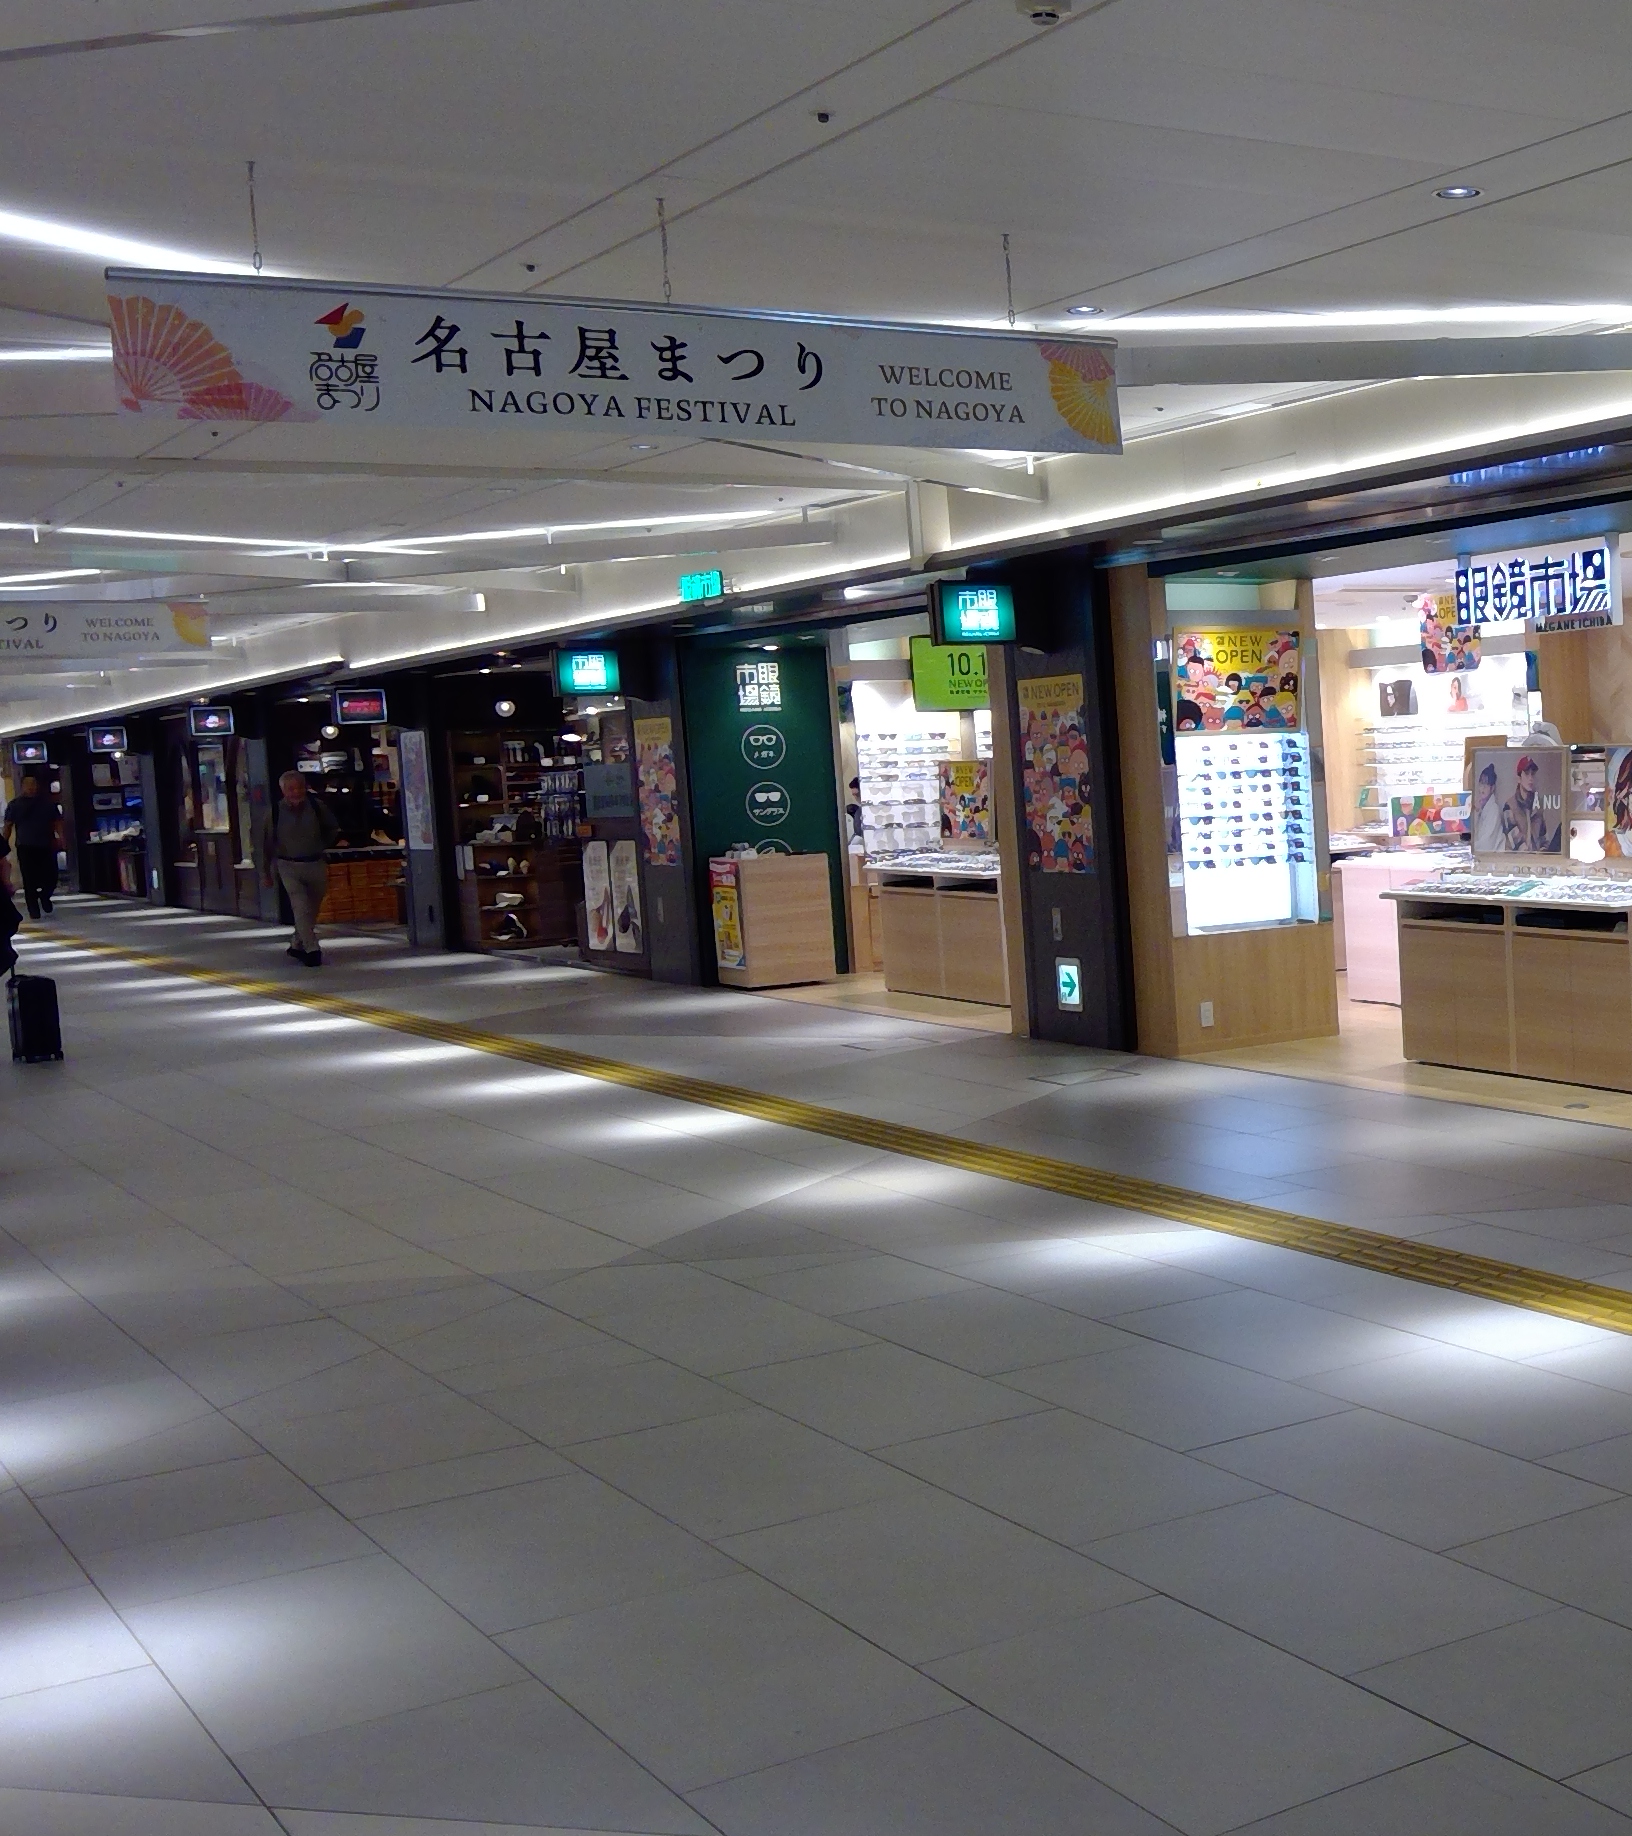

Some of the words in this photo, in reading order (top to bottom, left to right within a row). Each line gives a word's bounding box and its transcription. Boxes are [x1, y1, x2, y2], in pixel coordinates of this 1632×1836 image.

[411, 314, 825, 391] 名古屋まつり
[878, 364, 1014, 392] WELCOME
[469, 388, 625, 418] NAGOYA
[635, 396, 797, 427] FESTIVAL
[871, 397, 907, 418] TO
[915, 400, 1026, 425] NAGOYA
[1455, 547, 1611, 626] 眼鏡市場
[85, 617, 154, 628] WELCOME
[81, 632, 99, 642] TO
[103, 631, 160, 642] NAGOYA
[1228, 635, 1262, 648] NEW
[1215, 648, 1262, 665] OPEN
[1031, 683, 1052, 700] NEW
[1052, 681, 1080, 697] OPEN
